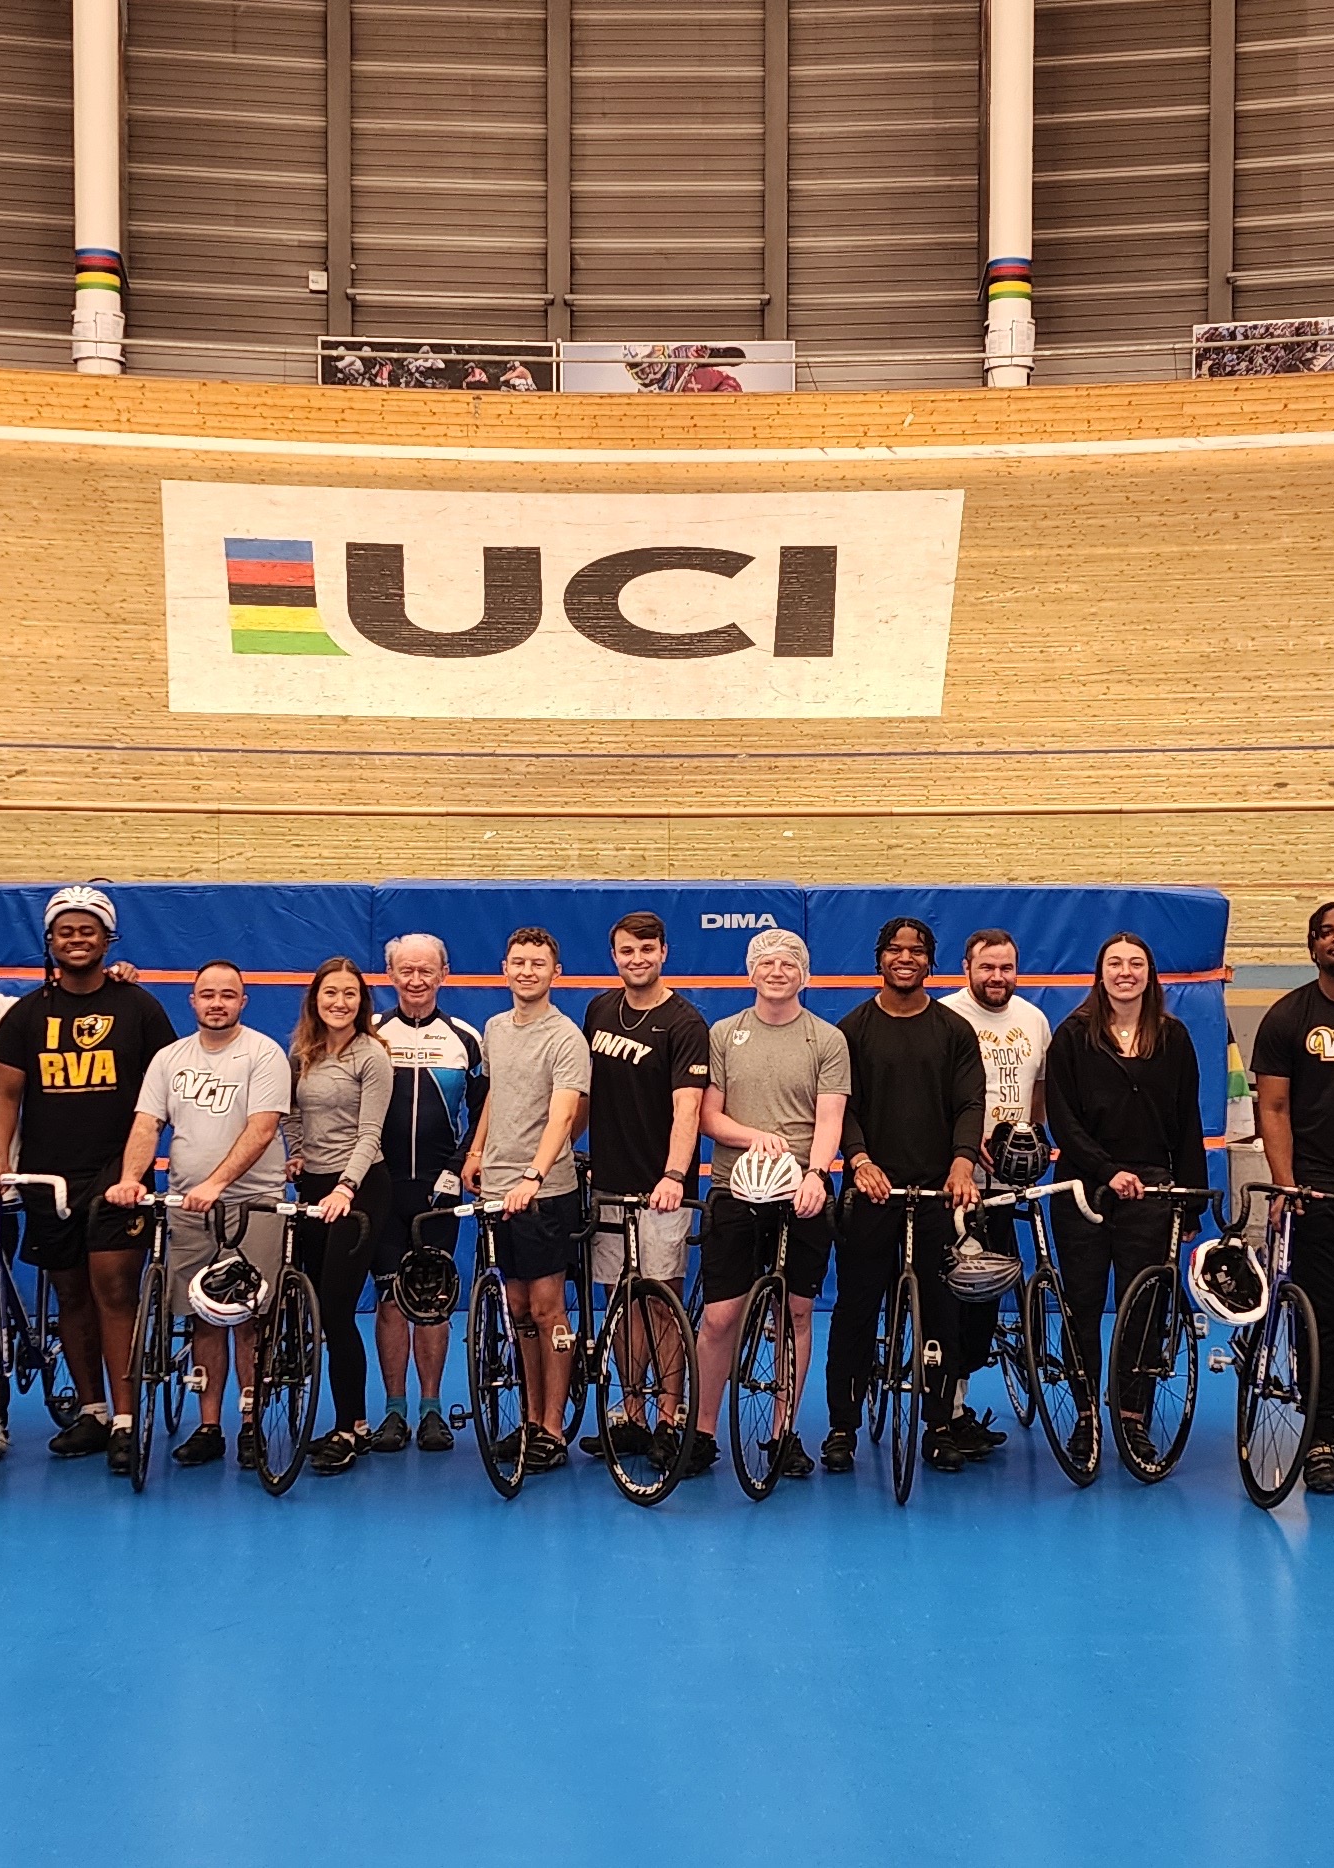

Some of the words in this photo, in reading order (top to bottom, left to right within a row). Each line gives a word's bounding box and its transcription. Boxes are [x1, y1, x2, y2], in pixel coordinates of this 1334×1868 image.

[345, 541, 838, 659] UCI
[701, 913, 778, 929] DIMA
[591, 1029, 653, 1065] UNITY
[992, 1048, 1023, 1066] ROCK
[39, 1050, 117, 1087] RVA
[999, 1067, 1019, 1085] THE
[172, 1068, 241, 1114] VCU
[999, 1085, 1020, 1103] STU
[992, 1106, 1025, 1122] VCU
[628, 1222, 637, 1267] LOOK
[779, 1222, 789, 1266] LOOK
